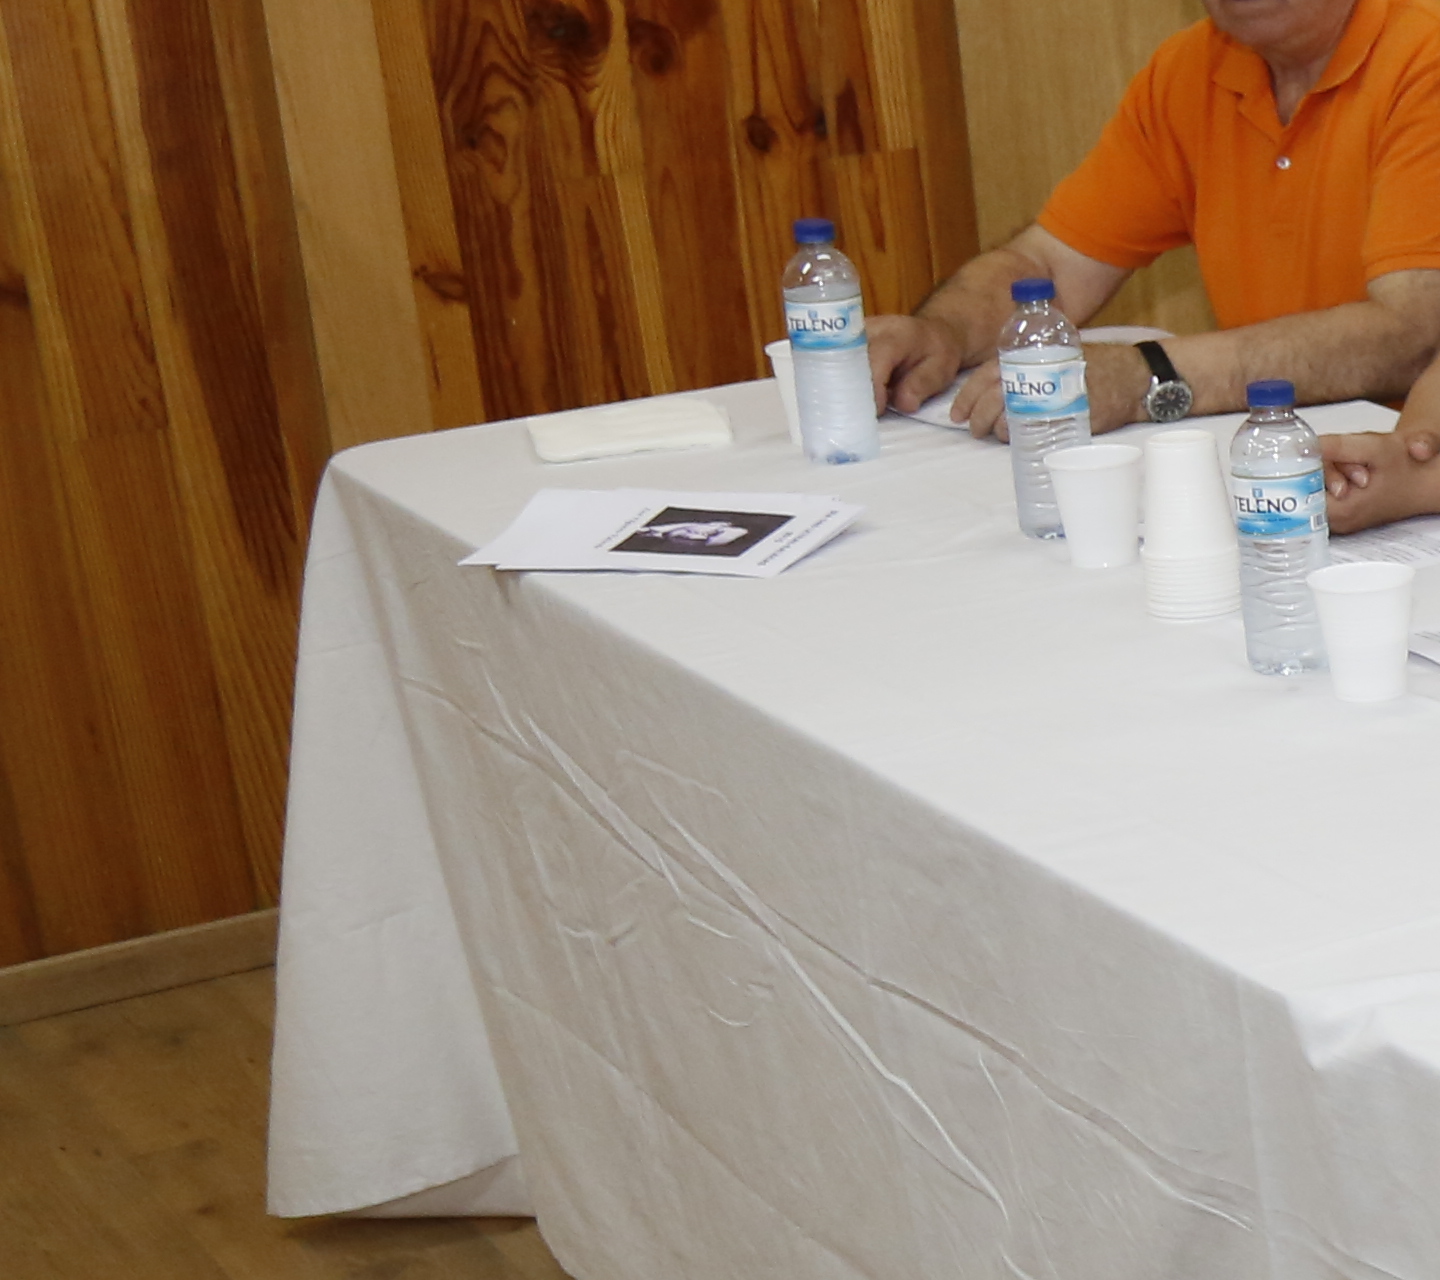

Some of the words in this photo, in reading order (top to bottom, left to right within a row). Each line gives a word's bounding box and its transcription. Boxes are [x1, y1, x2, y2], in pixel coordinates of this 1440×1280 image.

[788, 316, 847, 333] TELENO
[1003, 380, 1057, 396] ELENO
[1233, 494, 1298, 514] TELENO
